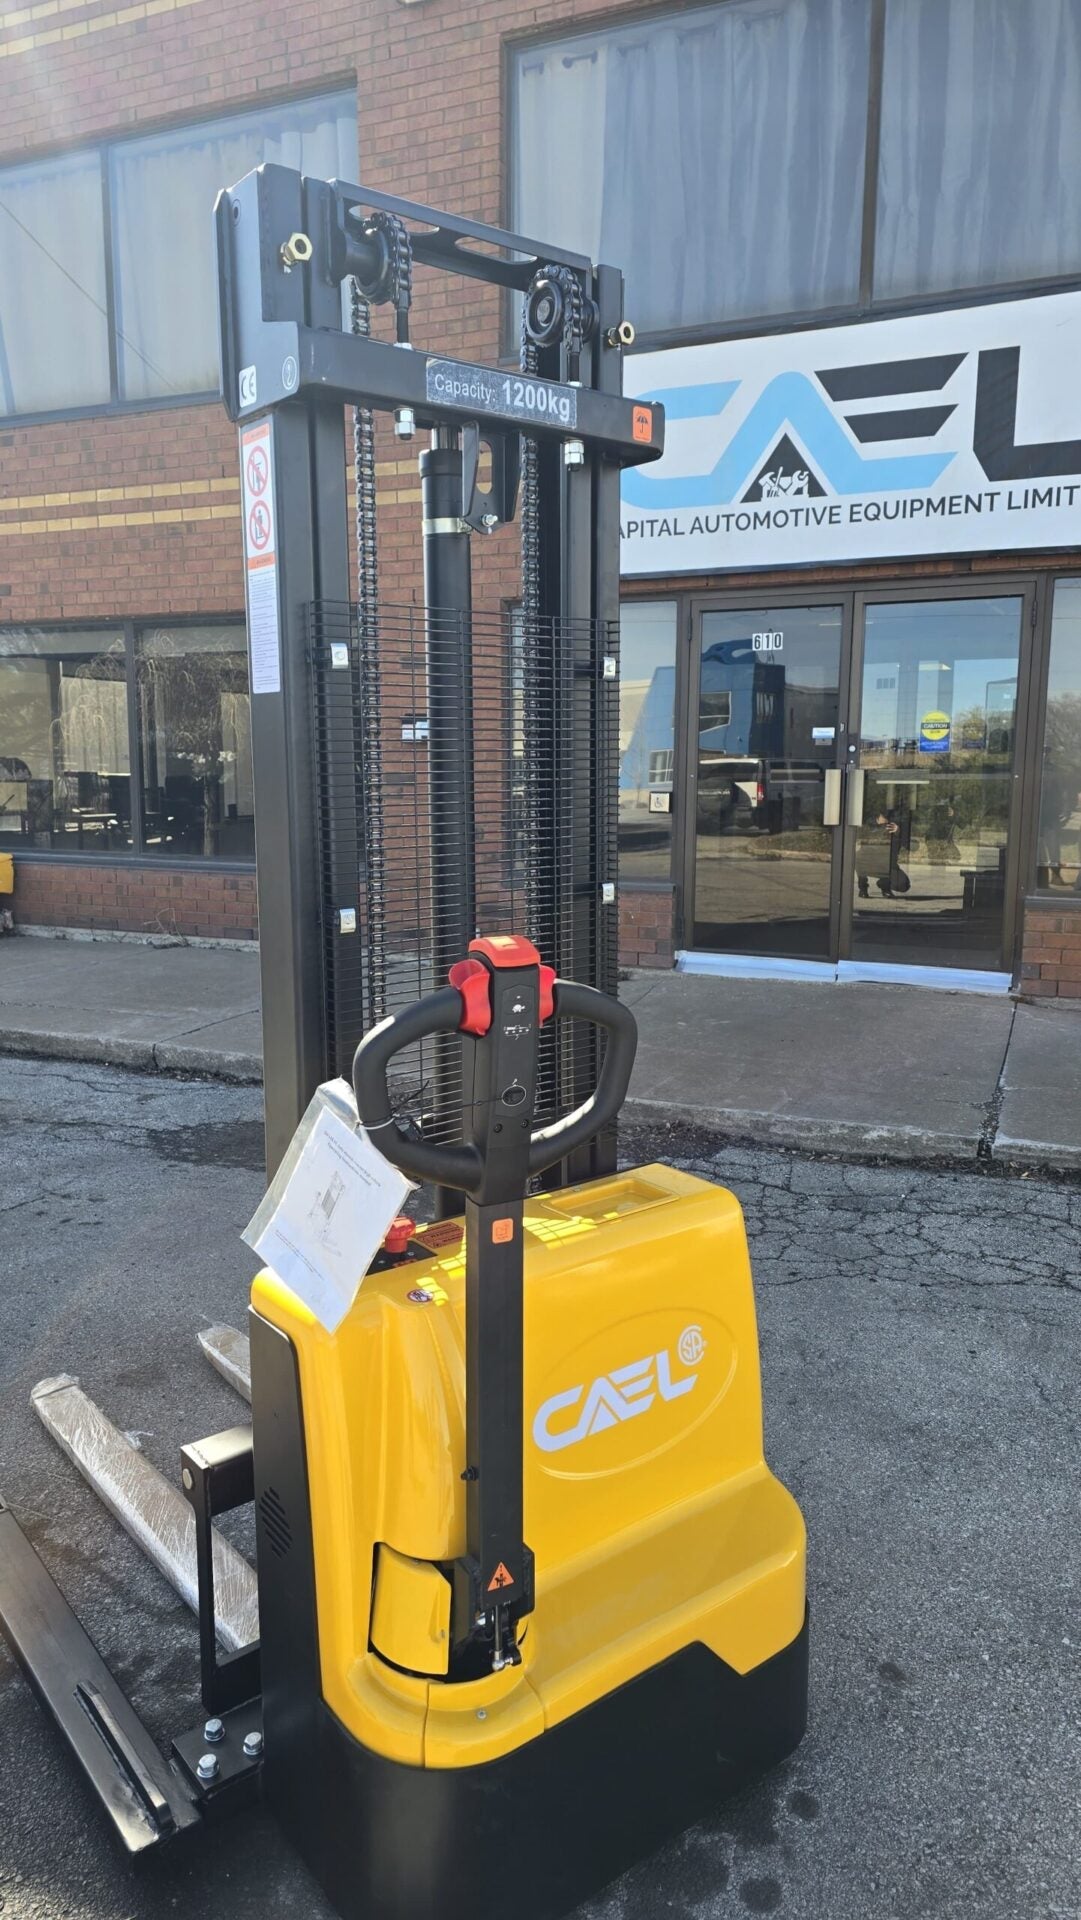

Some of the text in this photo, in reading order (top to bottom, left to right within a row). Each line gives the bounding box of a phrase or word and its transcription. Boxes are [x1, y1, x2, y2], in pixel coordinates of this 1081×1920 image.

[241, 371, 255, 400] CE
[434, 373, 570, 422] Capacity: 1200kg
[621, 346, 1081, 510] CAEL
[689, 505, 842, 535] AUTOMOTIVE
[849, 491, 1001, 522] EQUIPMENT
[1007, 484, 1081, 511] LIMIT
[753, 632, 783, 651] 610
[532, 1349, 698, 1453] CAEL
